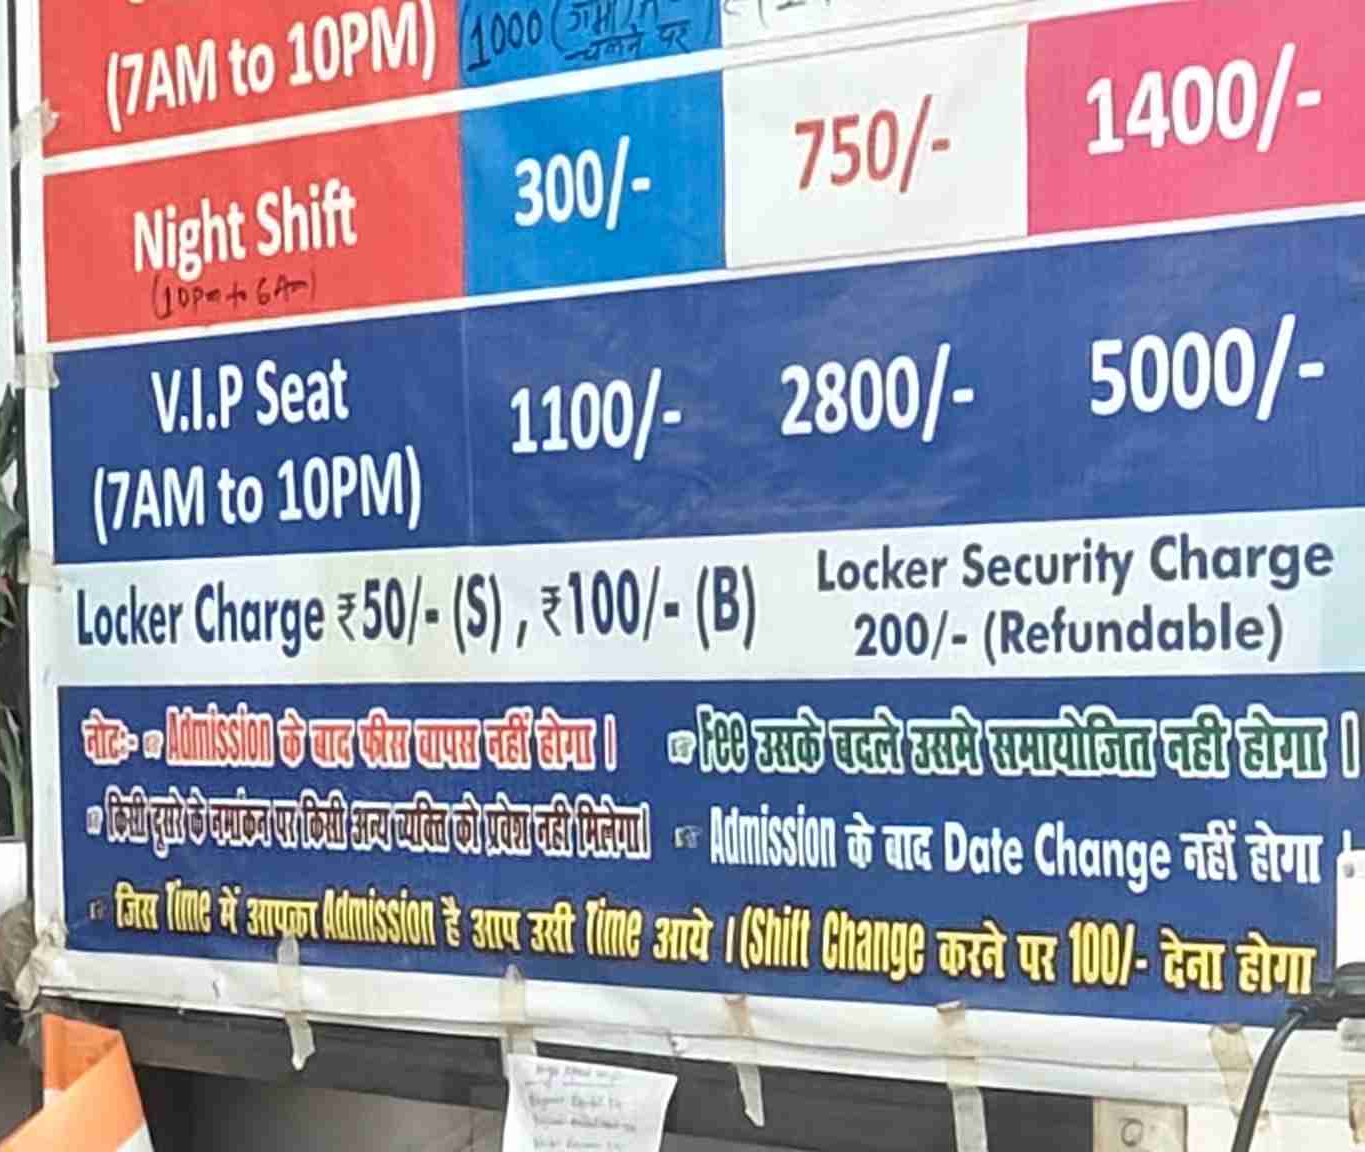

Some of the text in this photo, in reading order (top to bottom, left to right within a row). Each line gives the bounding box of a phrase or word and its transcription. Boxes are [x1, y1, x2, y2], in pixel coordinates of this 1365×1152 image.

[105, 0, 437, 133] (7AM to 10PM)
[1085, 42, 1322, 157] 1400/-
[514, 135, 651, 231] 300/-
[794, 93, 950, 193] 750/-
[133, 177, 357, 281] Night Shift
[150, 358, 349, 433] V.I.P Seat
[509, 367, 681, 462] 1100/-
[779, 341, 974, 443] 2800/-
[1089, 313, 1326, 422] 5000/-
[94, 445, 421, 546] (7AM to 10PM)
[77, 584, 183, 646] Locker
[194, 581, 325, 657] Charge
[454, 572, 501, 654] (S)
[696, 564, 756, 651] (B)
[816, 532, 1335, 596] Locker Security Charge
[853, 602, 1284, 666] 200/- (Refundable)
[166, 702, 274, 765] Admission
[277, 708, 306, 766] के
[309, 720, 355, 767] बाद
[358, 707, 411, 768] फीस
[414, 719, 480, 769] वापस
[484, 706, 533, 769] नहीं
[535, 706, 596, 770] होगा
[697, 704, 748, 773] Fee
[751, 705, 826, 774] उसके
[829, 705, 905, 774] बदले
[986, 705, 1156, 777] समायोजित
[1235, 704, 1328, 779] होगा
[105, 785, 149, 842] किसी
[149, 786, 185, 858] दूसरे
[186, 786, 207, 845] के
[273, 800, 298, 848] पर
[299, 789, 348, 849] किसी
[350, 802, 391, 850] अन्य
[452, 791, 482, 851] को
[483, 791, 530, 856] प्रवेश
[709, 803, 1323, 893] Admission के बाद Date Change नहीं होगा
[114, 881, 158, 929] जिस
[165, 879, 212, 934] Time
[217, 886, 241, 935] में
[247, 899, 319, 940] आपका
[322, 888, 436, 946] Admission
[441, 895, 461, 947] है
[470, 908, 521, 952] आप
[527, 901, 575, 954] उसी
[584, 897, 642, 959] Time
[653, 909, 713, 963] आये
[822, 909, 926, 982] Change
[937, 920, 1006, 979] करने
[1016, 933, 1057, 983] पर
[1068, 921, 1147, 987] 100/-
[1161, 928, 1226, 991] देना
[1236, 931, 1318, 994] होगा
